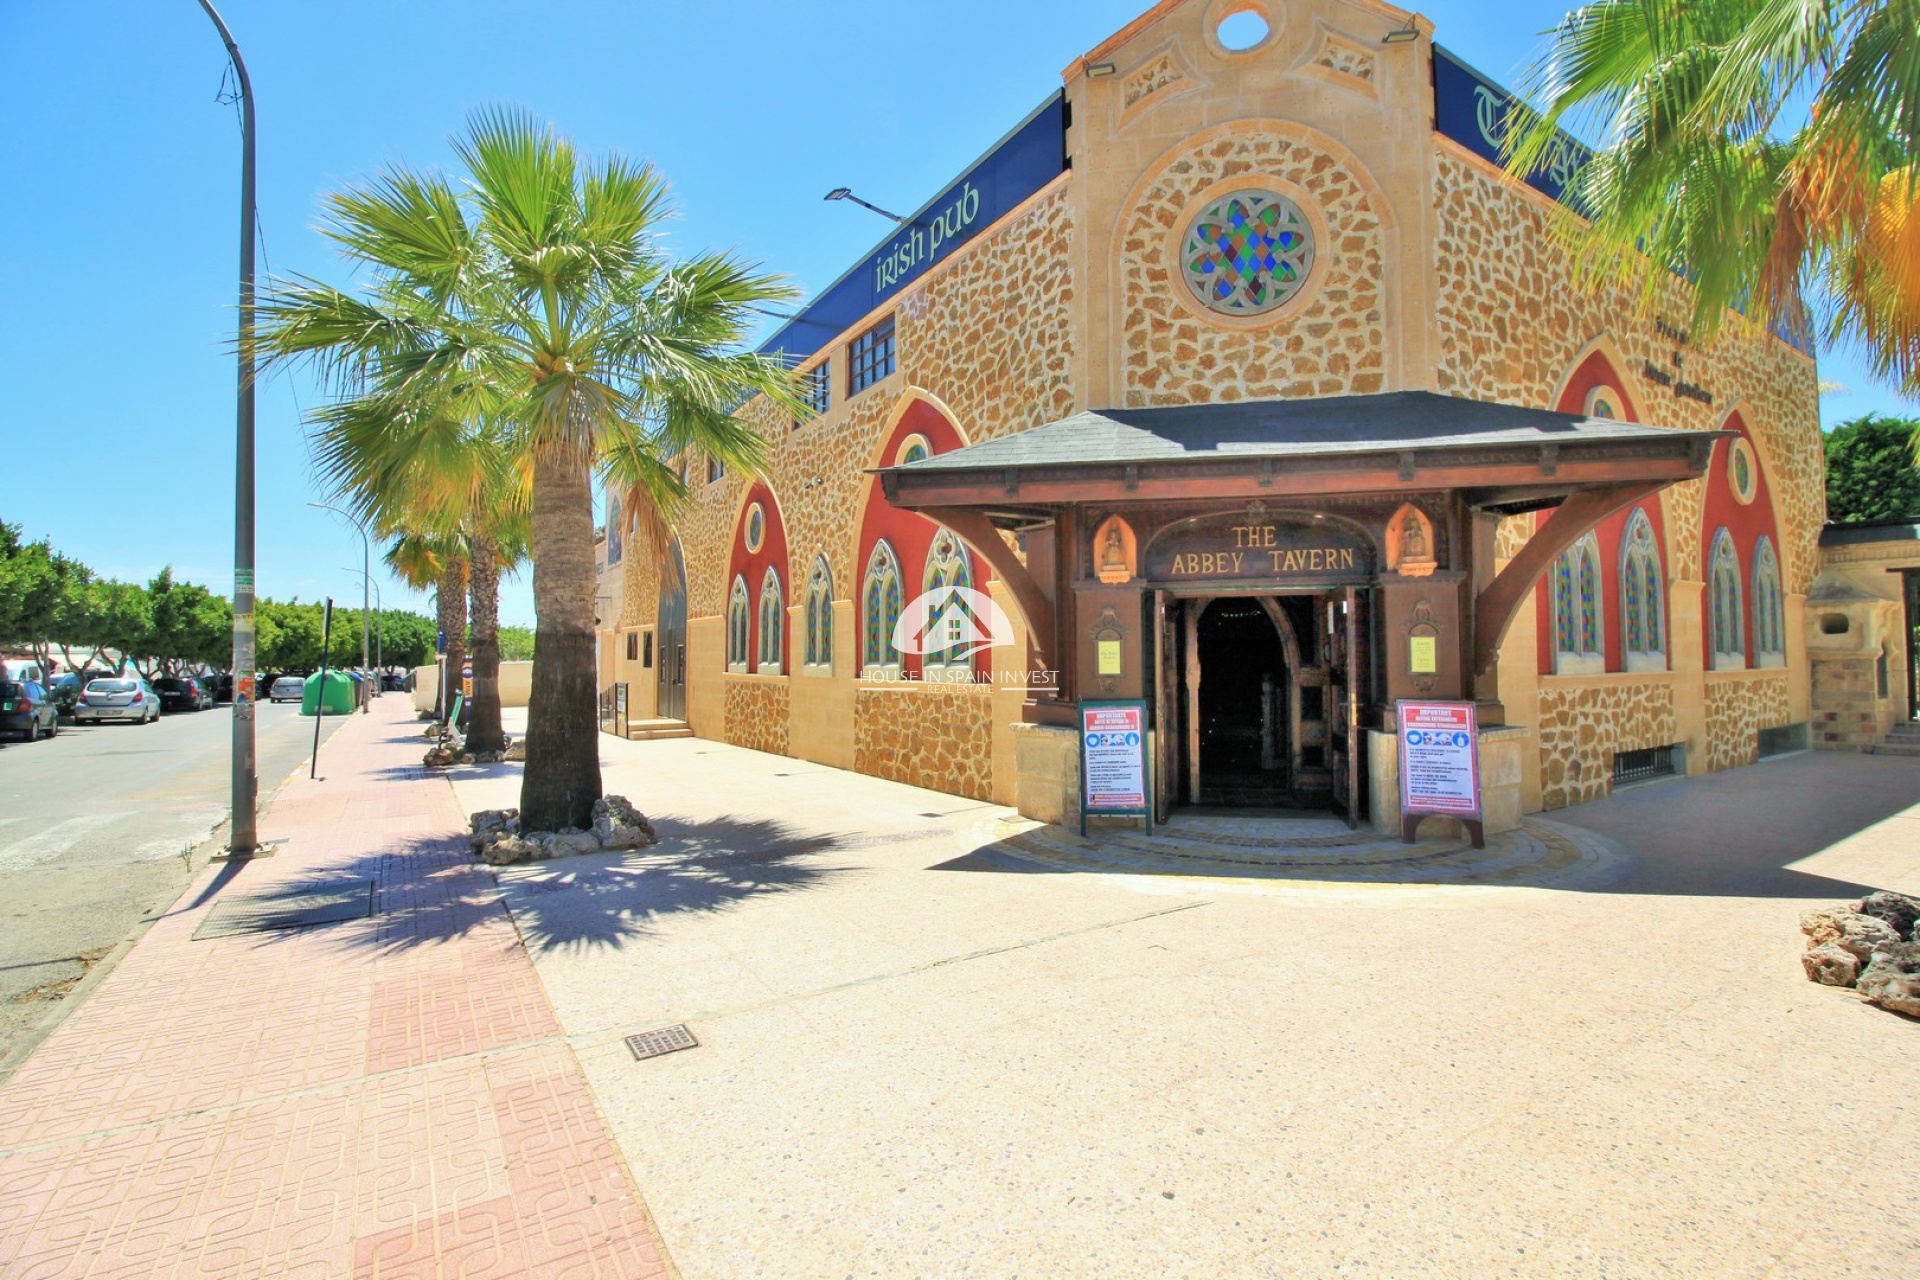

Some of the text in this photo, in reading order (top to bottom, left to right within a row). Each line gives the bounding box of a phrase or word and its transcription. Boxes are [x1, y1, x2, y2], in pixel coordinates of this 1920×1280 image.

[929, 182, 980, 262] pub
[1231, 525, 1277, 548] THE
[1171, 548, 1354, 574] ABBEY TAVERN
